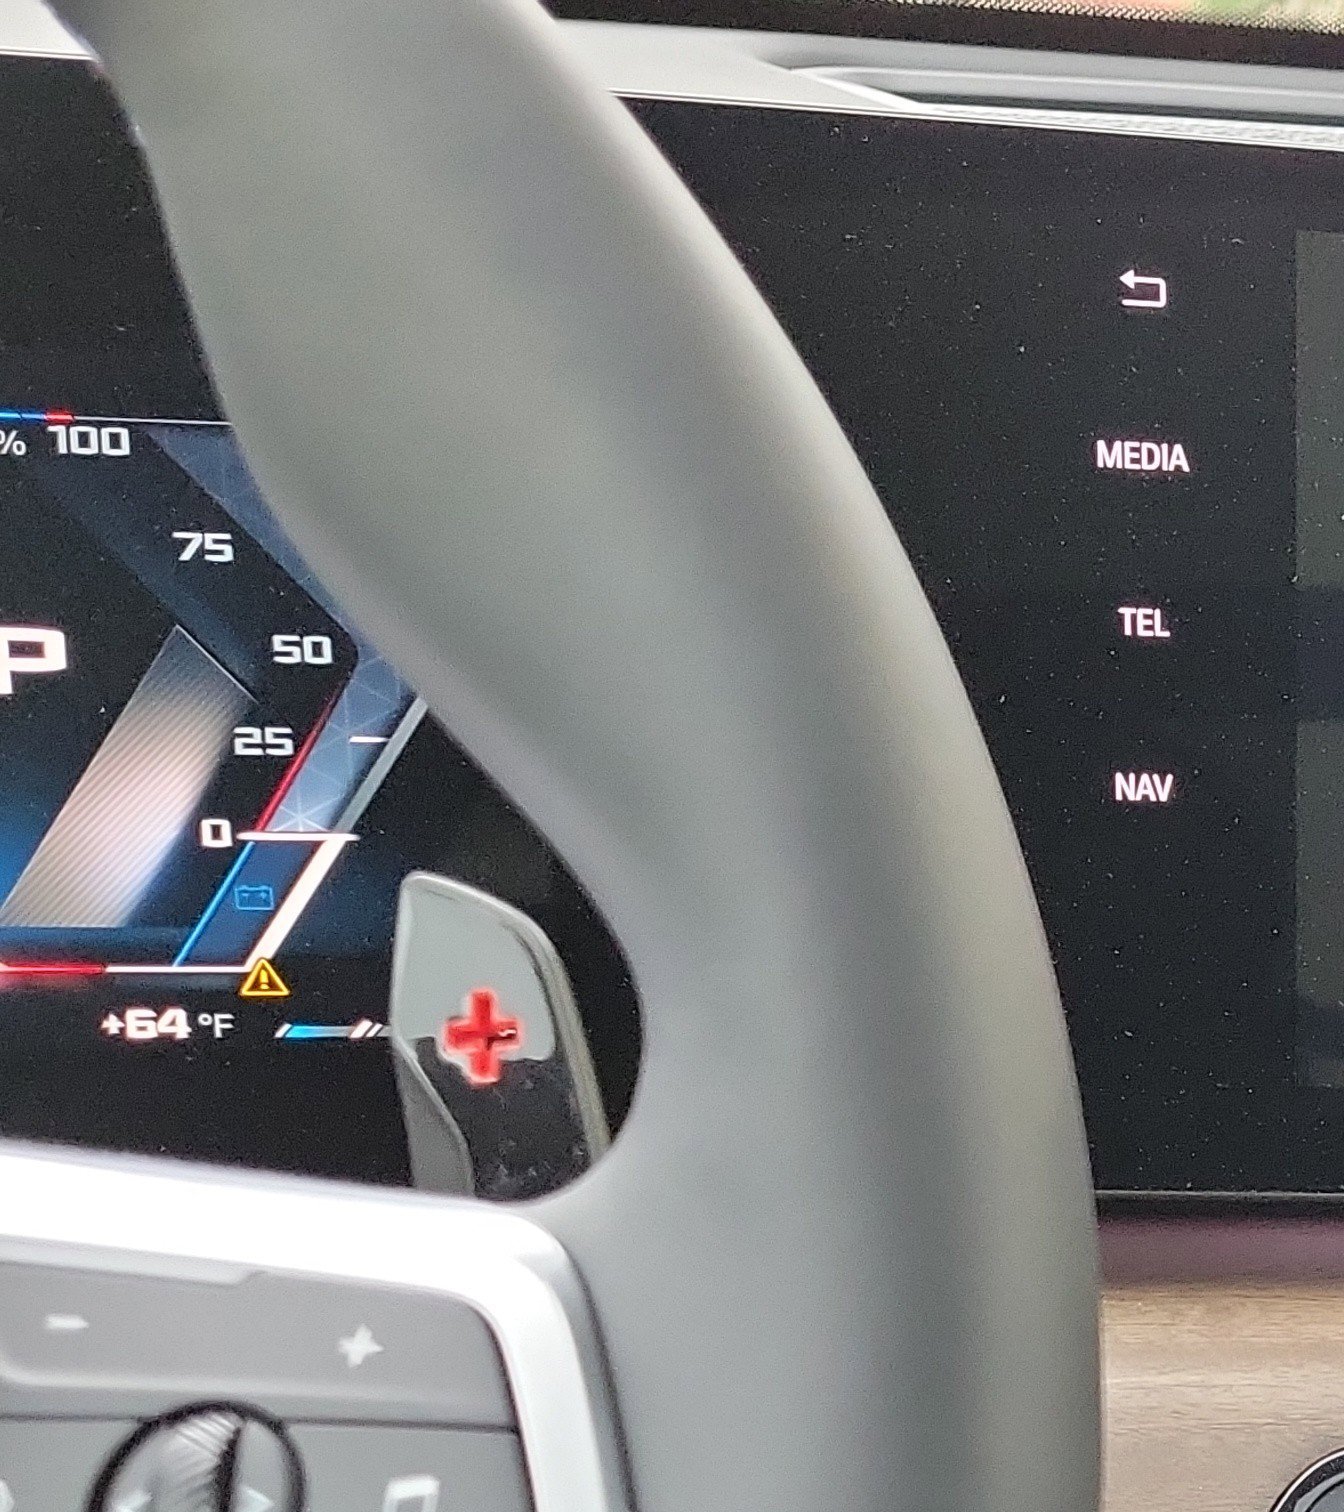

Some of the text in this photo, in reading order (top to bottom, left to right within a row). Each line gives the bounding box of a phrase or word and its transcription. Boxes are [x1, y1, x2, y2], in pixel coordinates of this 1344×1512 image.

[47, 425, 130, 456] 100
[1096, 440, 1189, 472] MEDIA
[172, 532, 234, 562] 75
[1118, 607, 1171, 637] TEL
[0, 626, 67, 694] P
[272, 635, 332, 664] 50
[234, 727, 294, 755] 25
[1115, 773, 1173, 802] NAV
[200, 819, 232, 846] 0
